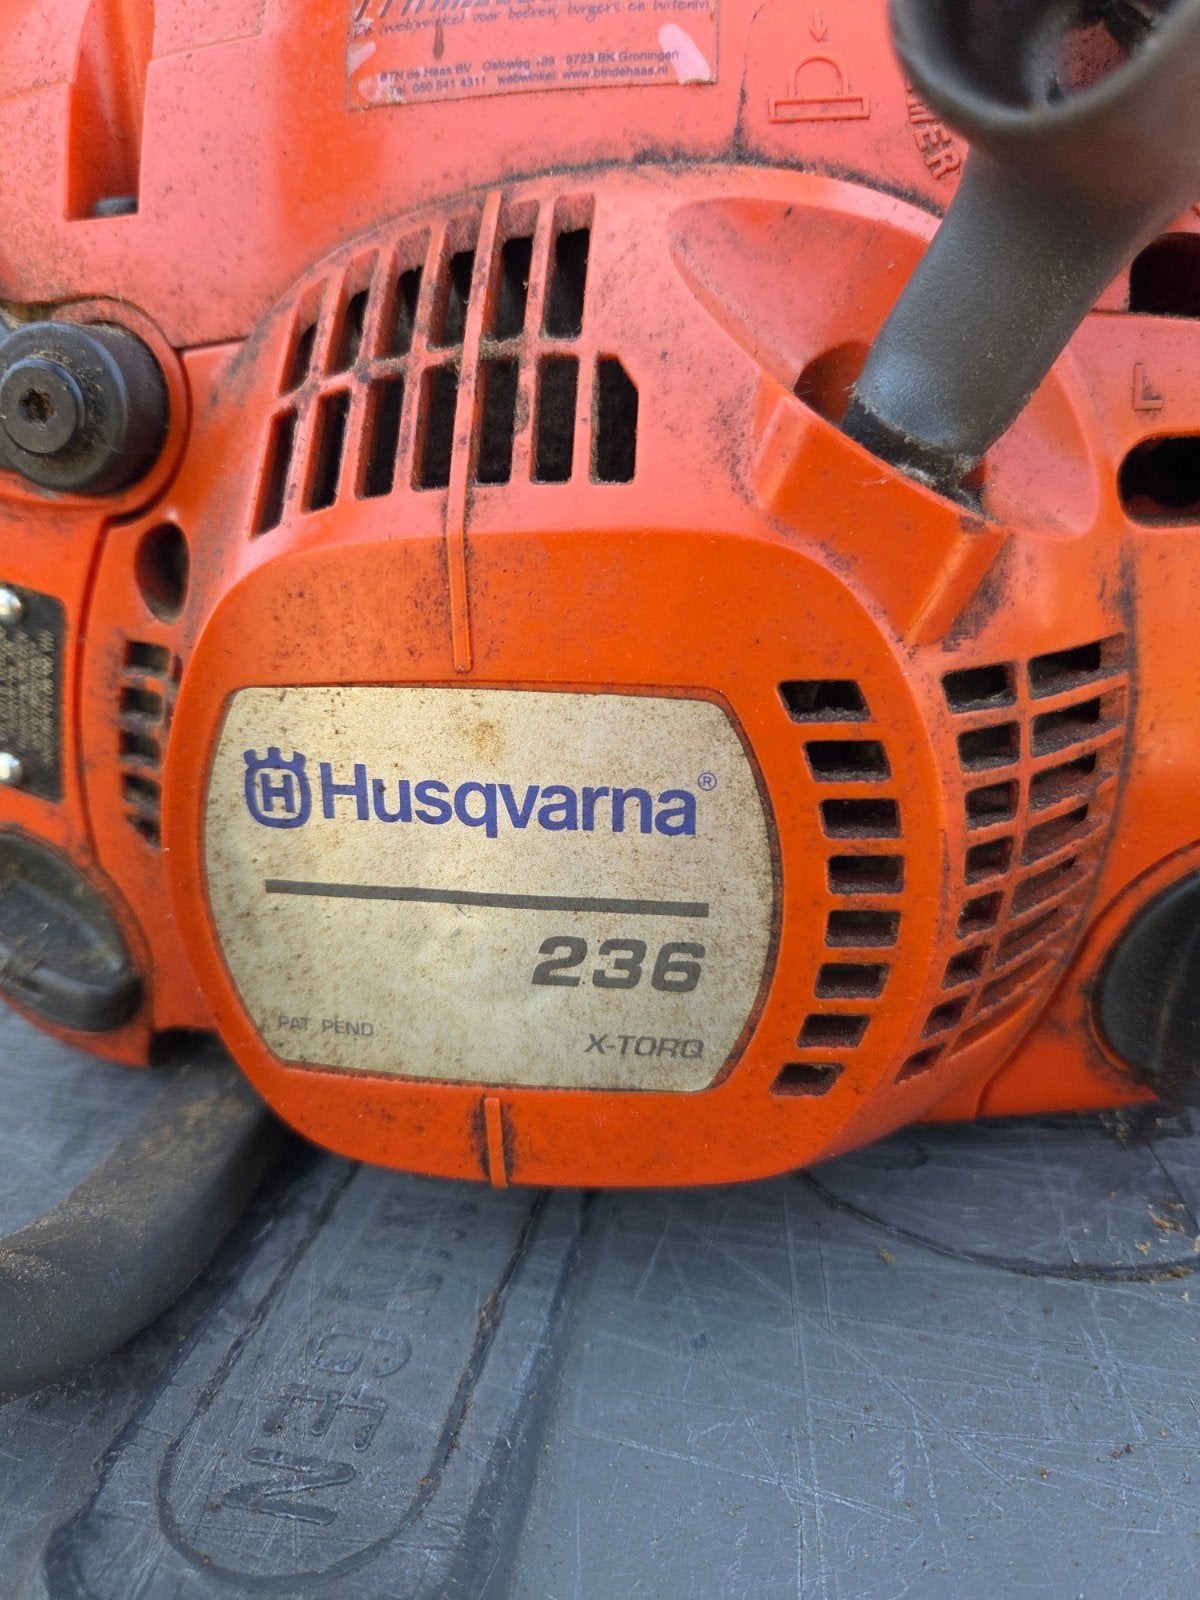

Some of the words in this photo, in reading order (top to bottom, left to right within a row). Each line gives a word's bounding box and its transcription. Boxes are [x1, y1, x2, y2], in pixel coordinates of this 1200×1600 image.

[473, 12, 499, 23] voor
[567, 1, 621, 24] burgers
[627, 1, 646, 12] en
[380, 72, 404, 83] BTN
[407, 69, 420, 80] de
[424, 65, 452, 77] Haas
[455, 62, 472, 74] BV
[482, 59, 531, 73] Osloweg
[566, 53, 594, 65] 9723
[598, 52, 615, 62] BK
[618, 50, 679, 63] Groningen
[412, 82, 432, 93] 050
[436, 80, 456, 92] 541
[460, 76, 486, 88] 4311
[319, 762, 697, 838] Husqvarna
[532, 935, 706, 993] 236
[584, 1033, 705, 1060] X-TORQ
